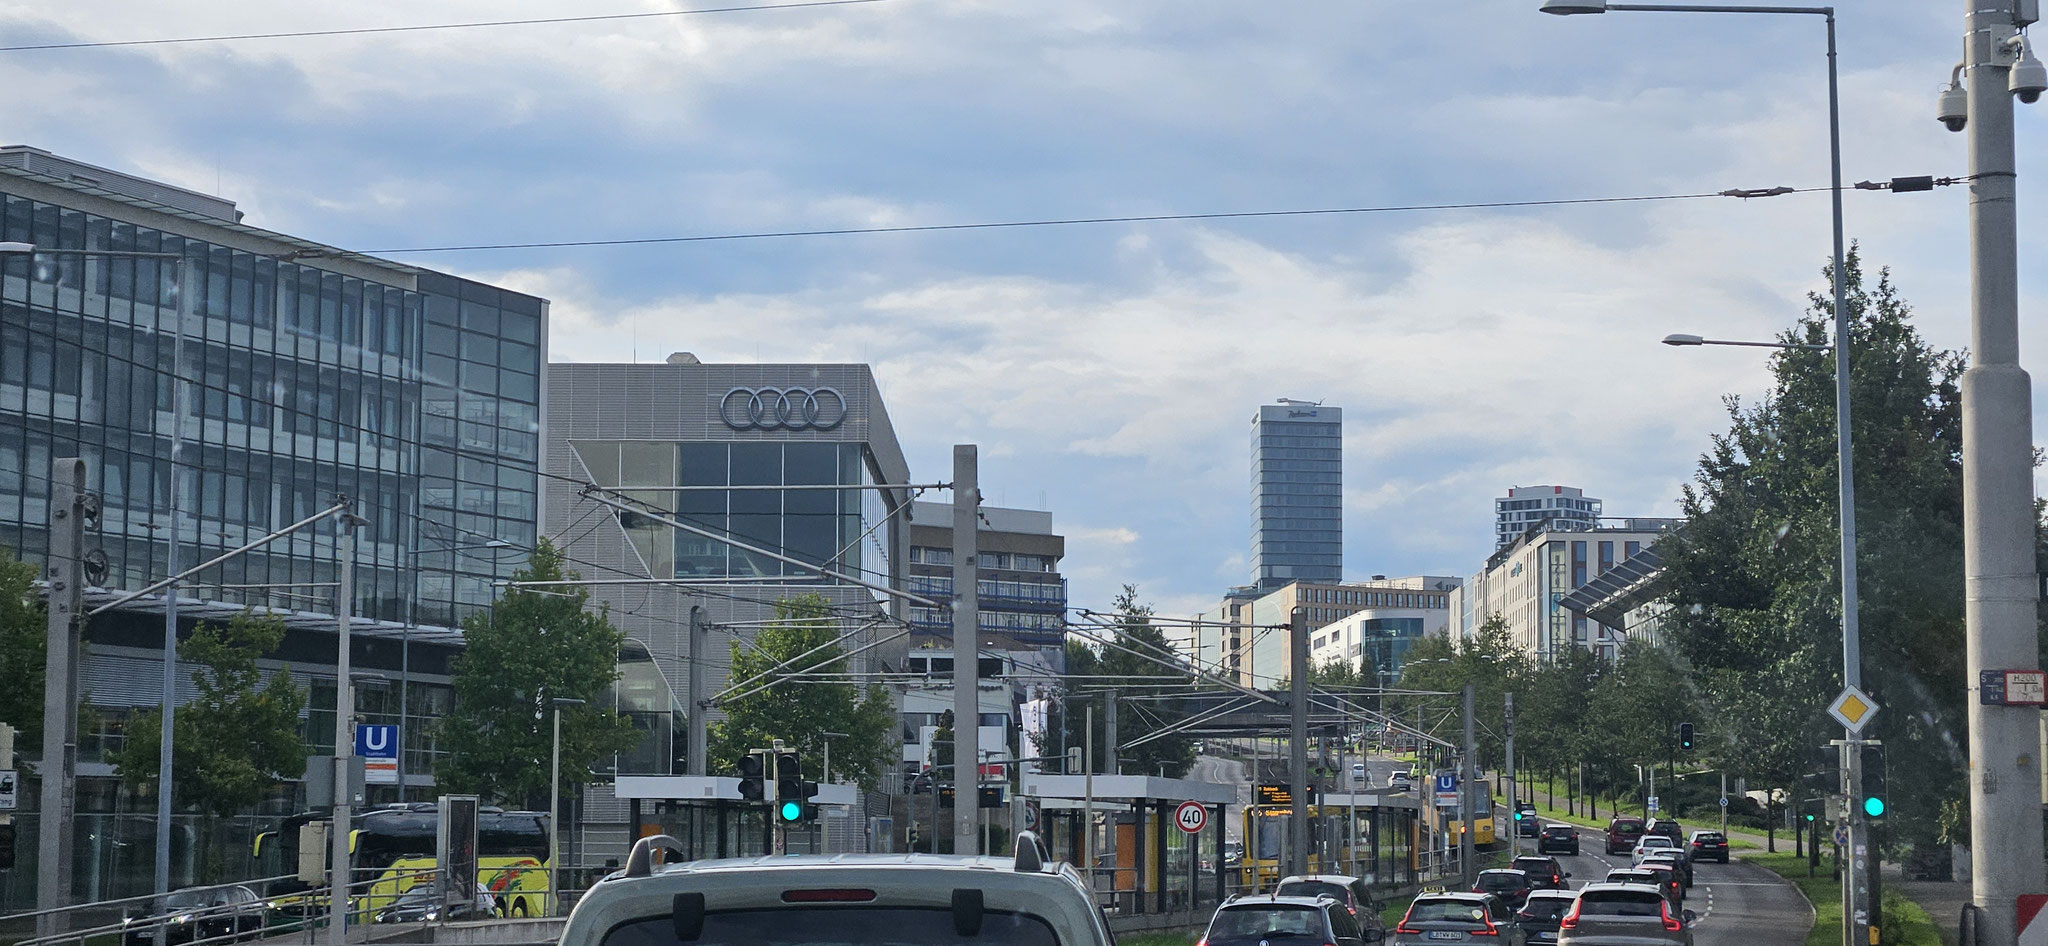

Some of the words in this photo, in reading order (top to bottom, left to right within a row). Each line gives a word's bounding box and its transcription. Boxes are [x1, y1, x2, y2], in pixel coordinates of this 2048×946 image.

[366, 727, 388, 750] U
[1441, 777, 1452, 788] U
[1182, 810, 1201, 824] 40
